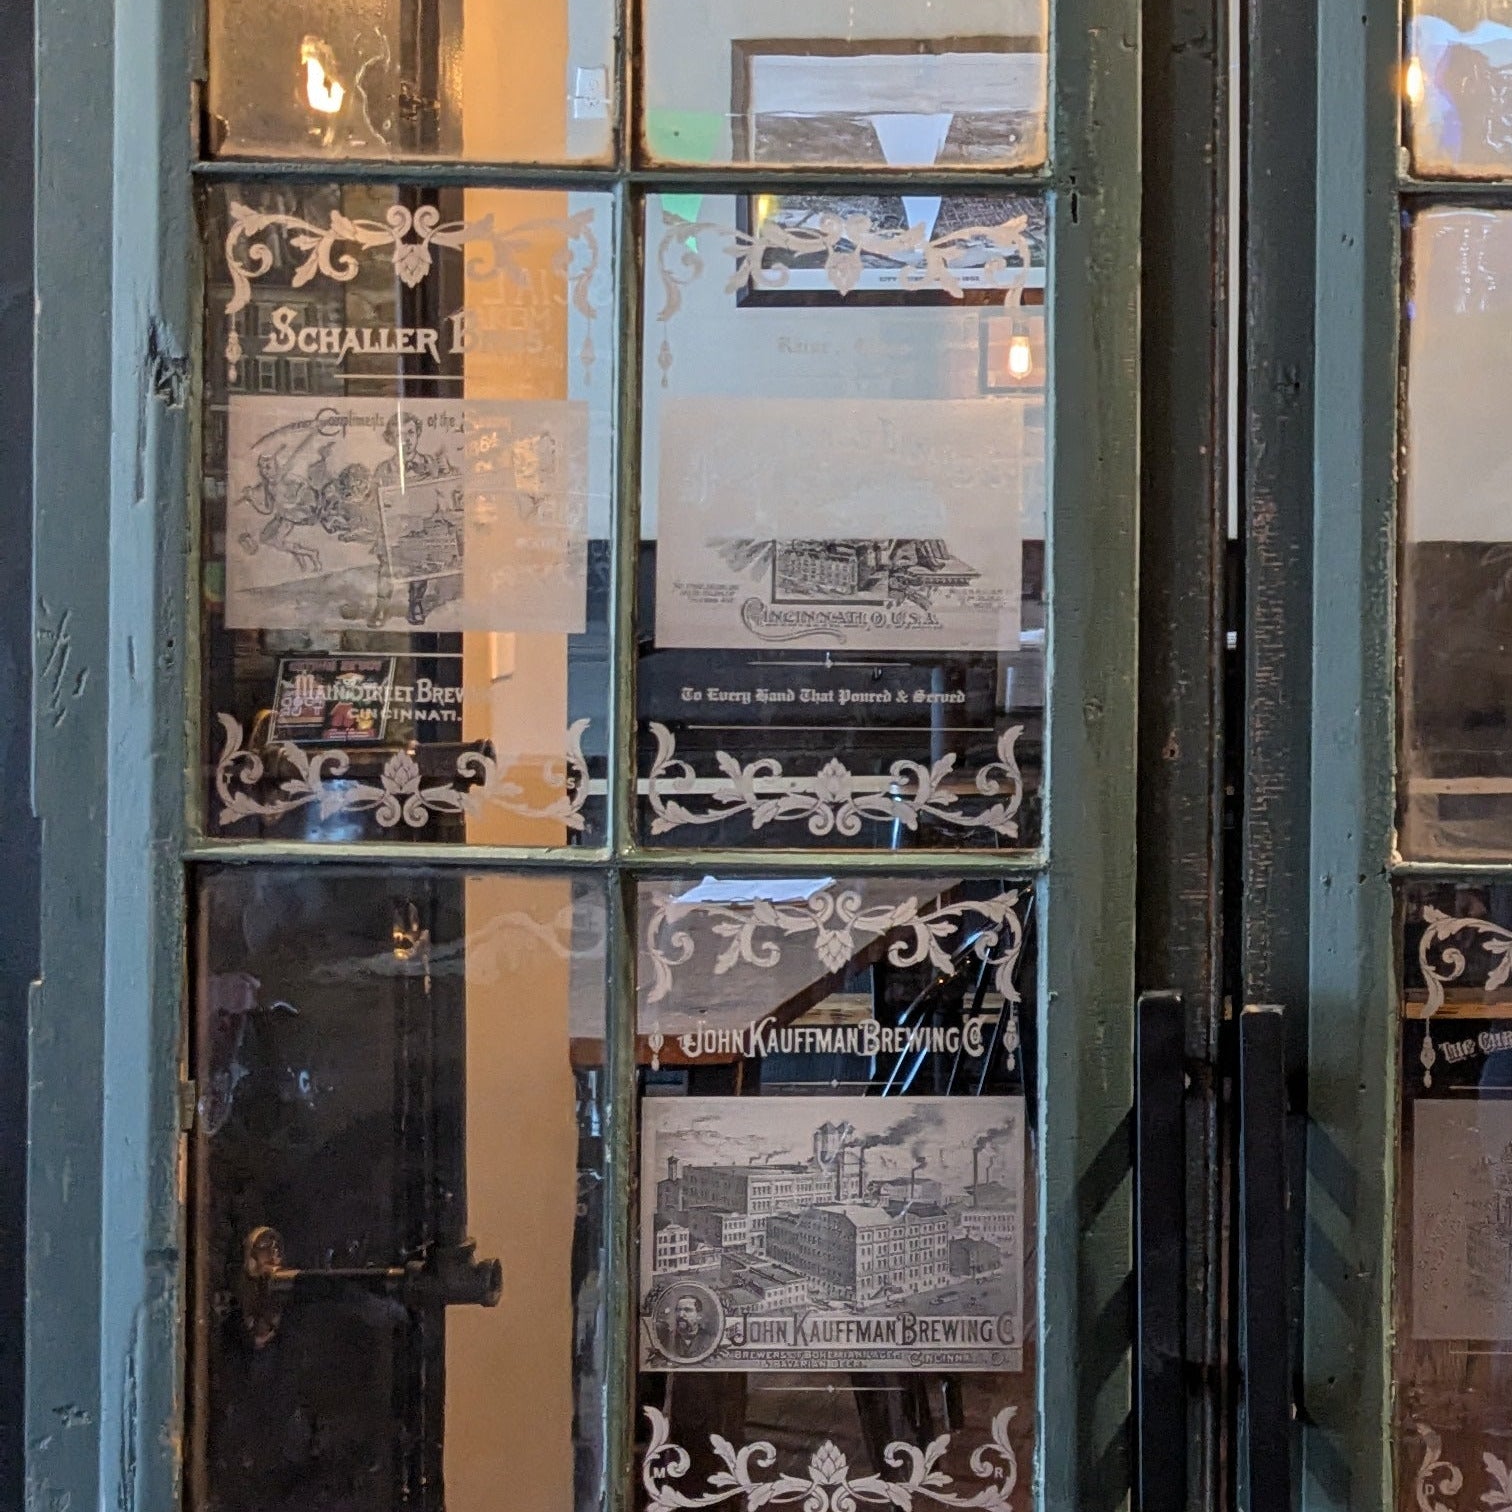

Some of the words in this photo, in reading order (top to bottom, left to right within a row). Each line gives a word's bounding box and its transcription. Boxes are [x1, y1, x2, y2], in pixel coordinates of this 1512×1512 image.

[262, 305, 440, 365] SCHALLER
[680, 686, 702, 702] To
[706, 686, 751, 705] Every
[754, 686, 796, 704] Hand
[799, 686, 835, 702] That
[838, 686, 892, 705] Poured
[895, 687, 909, 702] &
[911, 686, 967, 703] Served
[567, 776, 576, 790] S
[681, 1020, 745, 1058] JOHN
[743, 1016, 858, 1058] KAUFFMAN
[857, 1017, 960, 1057] BREWING
[731, 1312, 788, 1347] JOHN
[787, 1312, 897, 1347] KAUFFMAN
[895, 1312, 993, 1347] BREWING
[734, 1350, 787, 1360] BREWERS
[653, 1466, 666, 1479] M
[994, 1466, 1004, 1479] R
[1424, 1483, 1435, 1495] D
